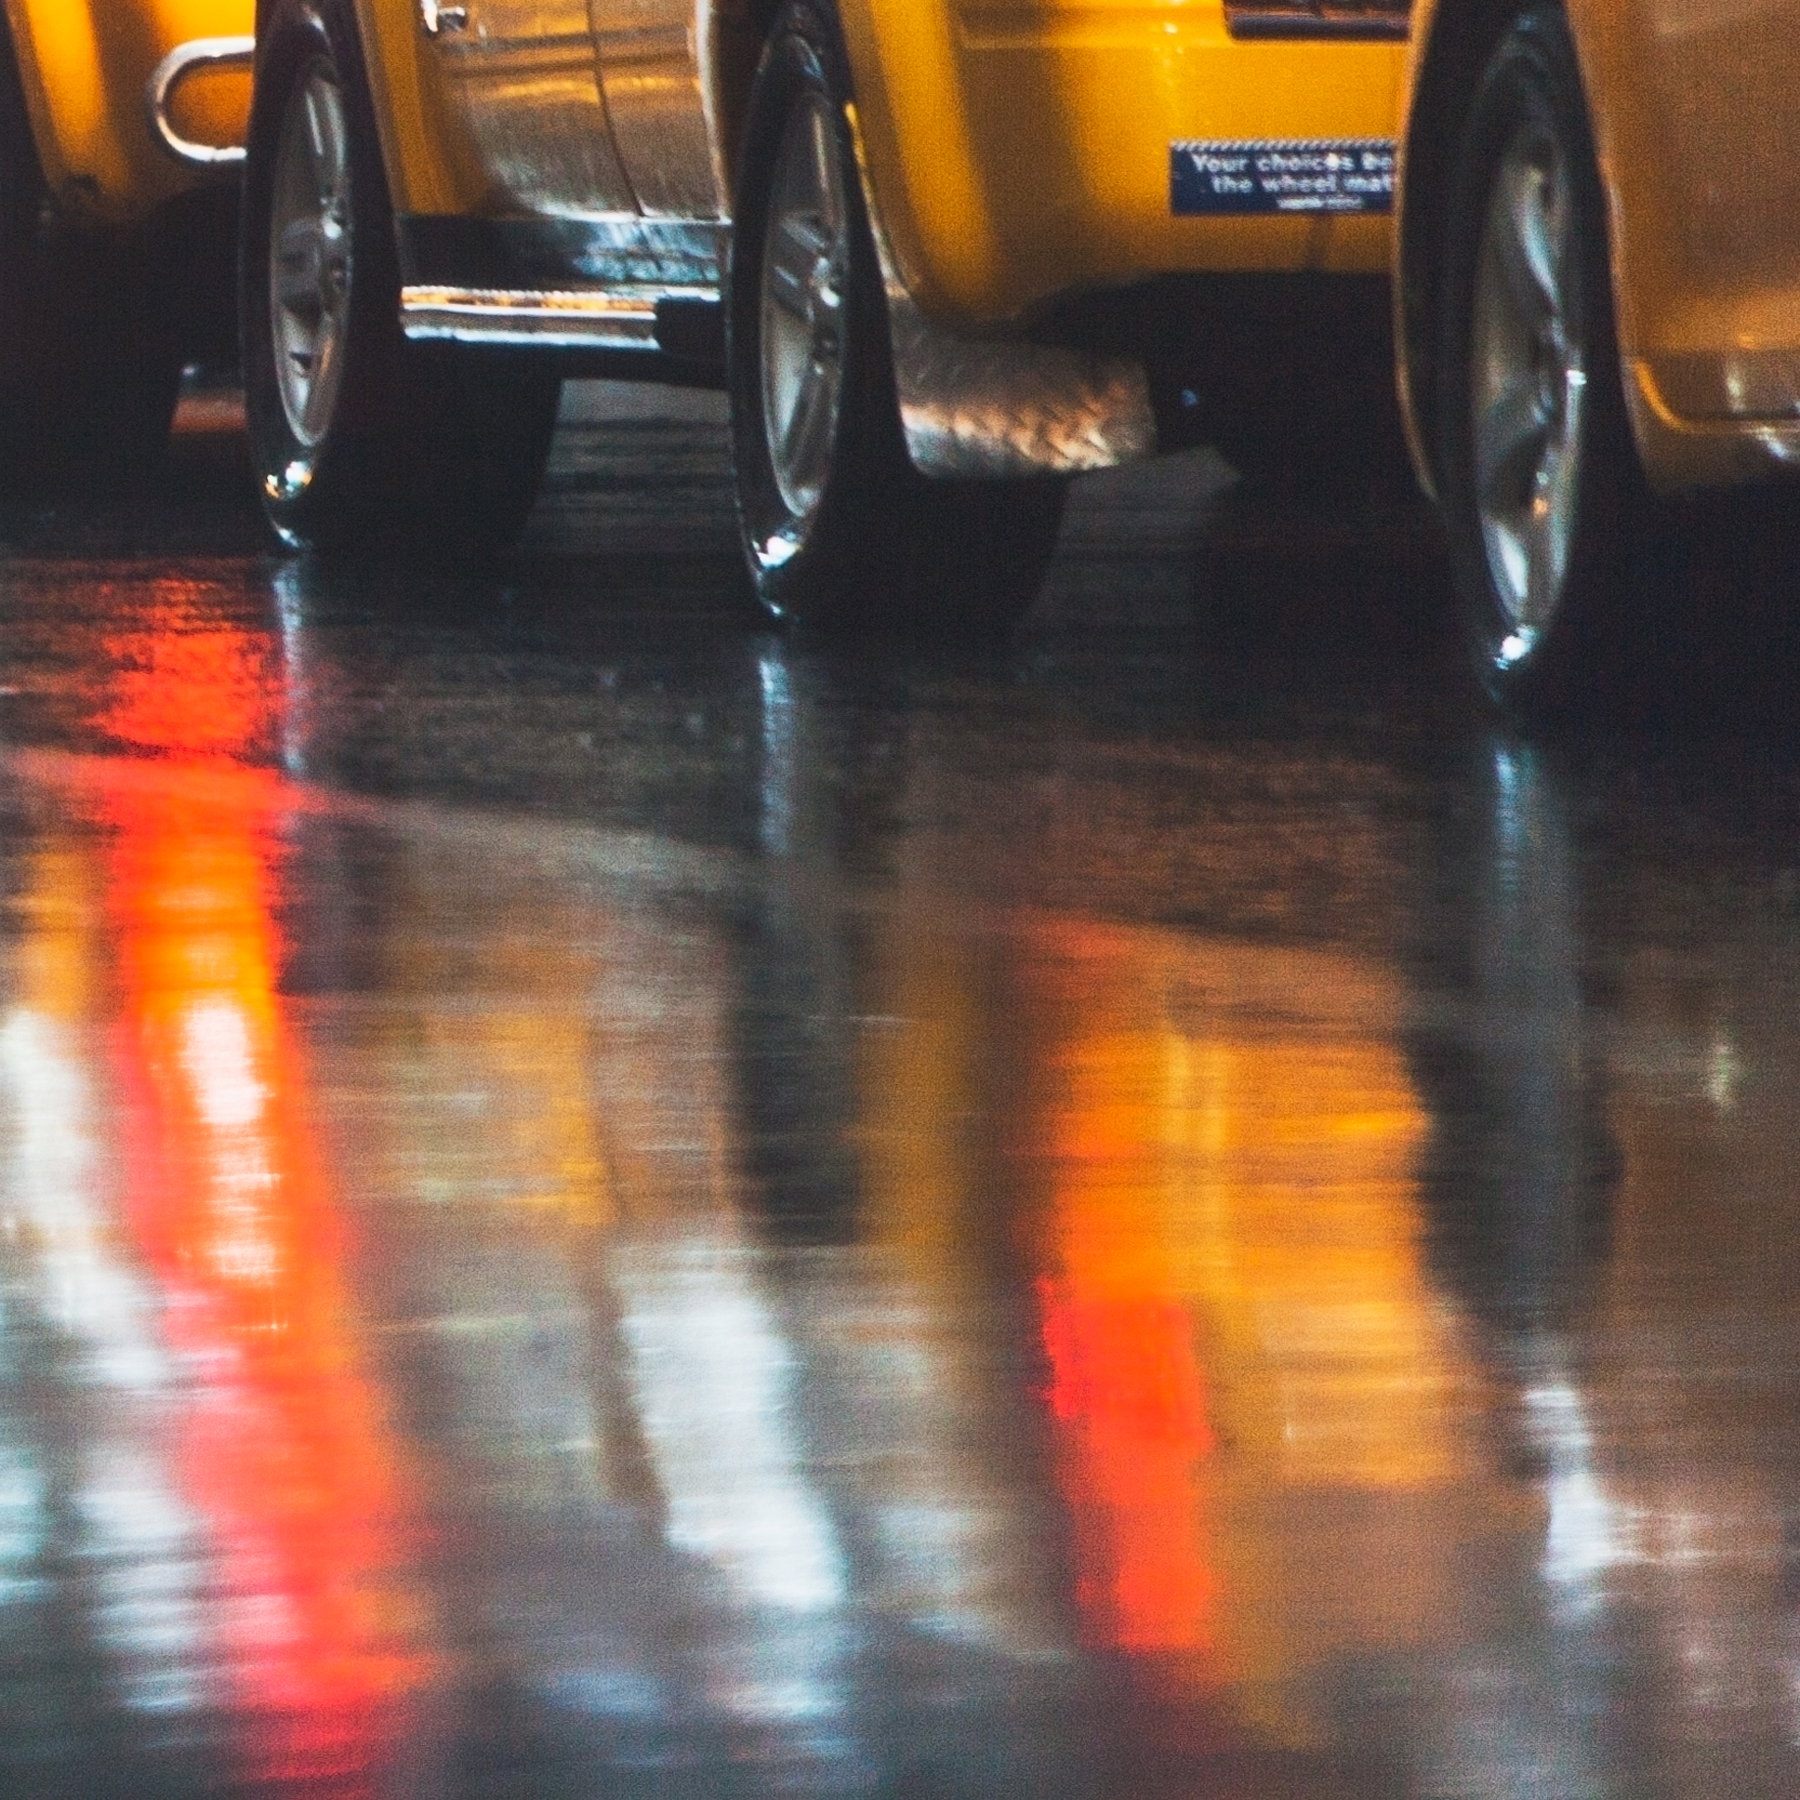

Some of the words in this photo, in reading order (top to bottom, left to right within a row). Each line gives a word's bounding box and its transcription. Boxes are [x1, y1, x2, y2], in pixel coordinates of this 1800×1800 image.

[1191, 153, 1249, 173] Your
[1255, 152, 1356, 173] choices
[1211, 174, 1253, 194] the
[1260, 173, 1338, 193] wheel
[1343, 173, 1393, 193] mat
